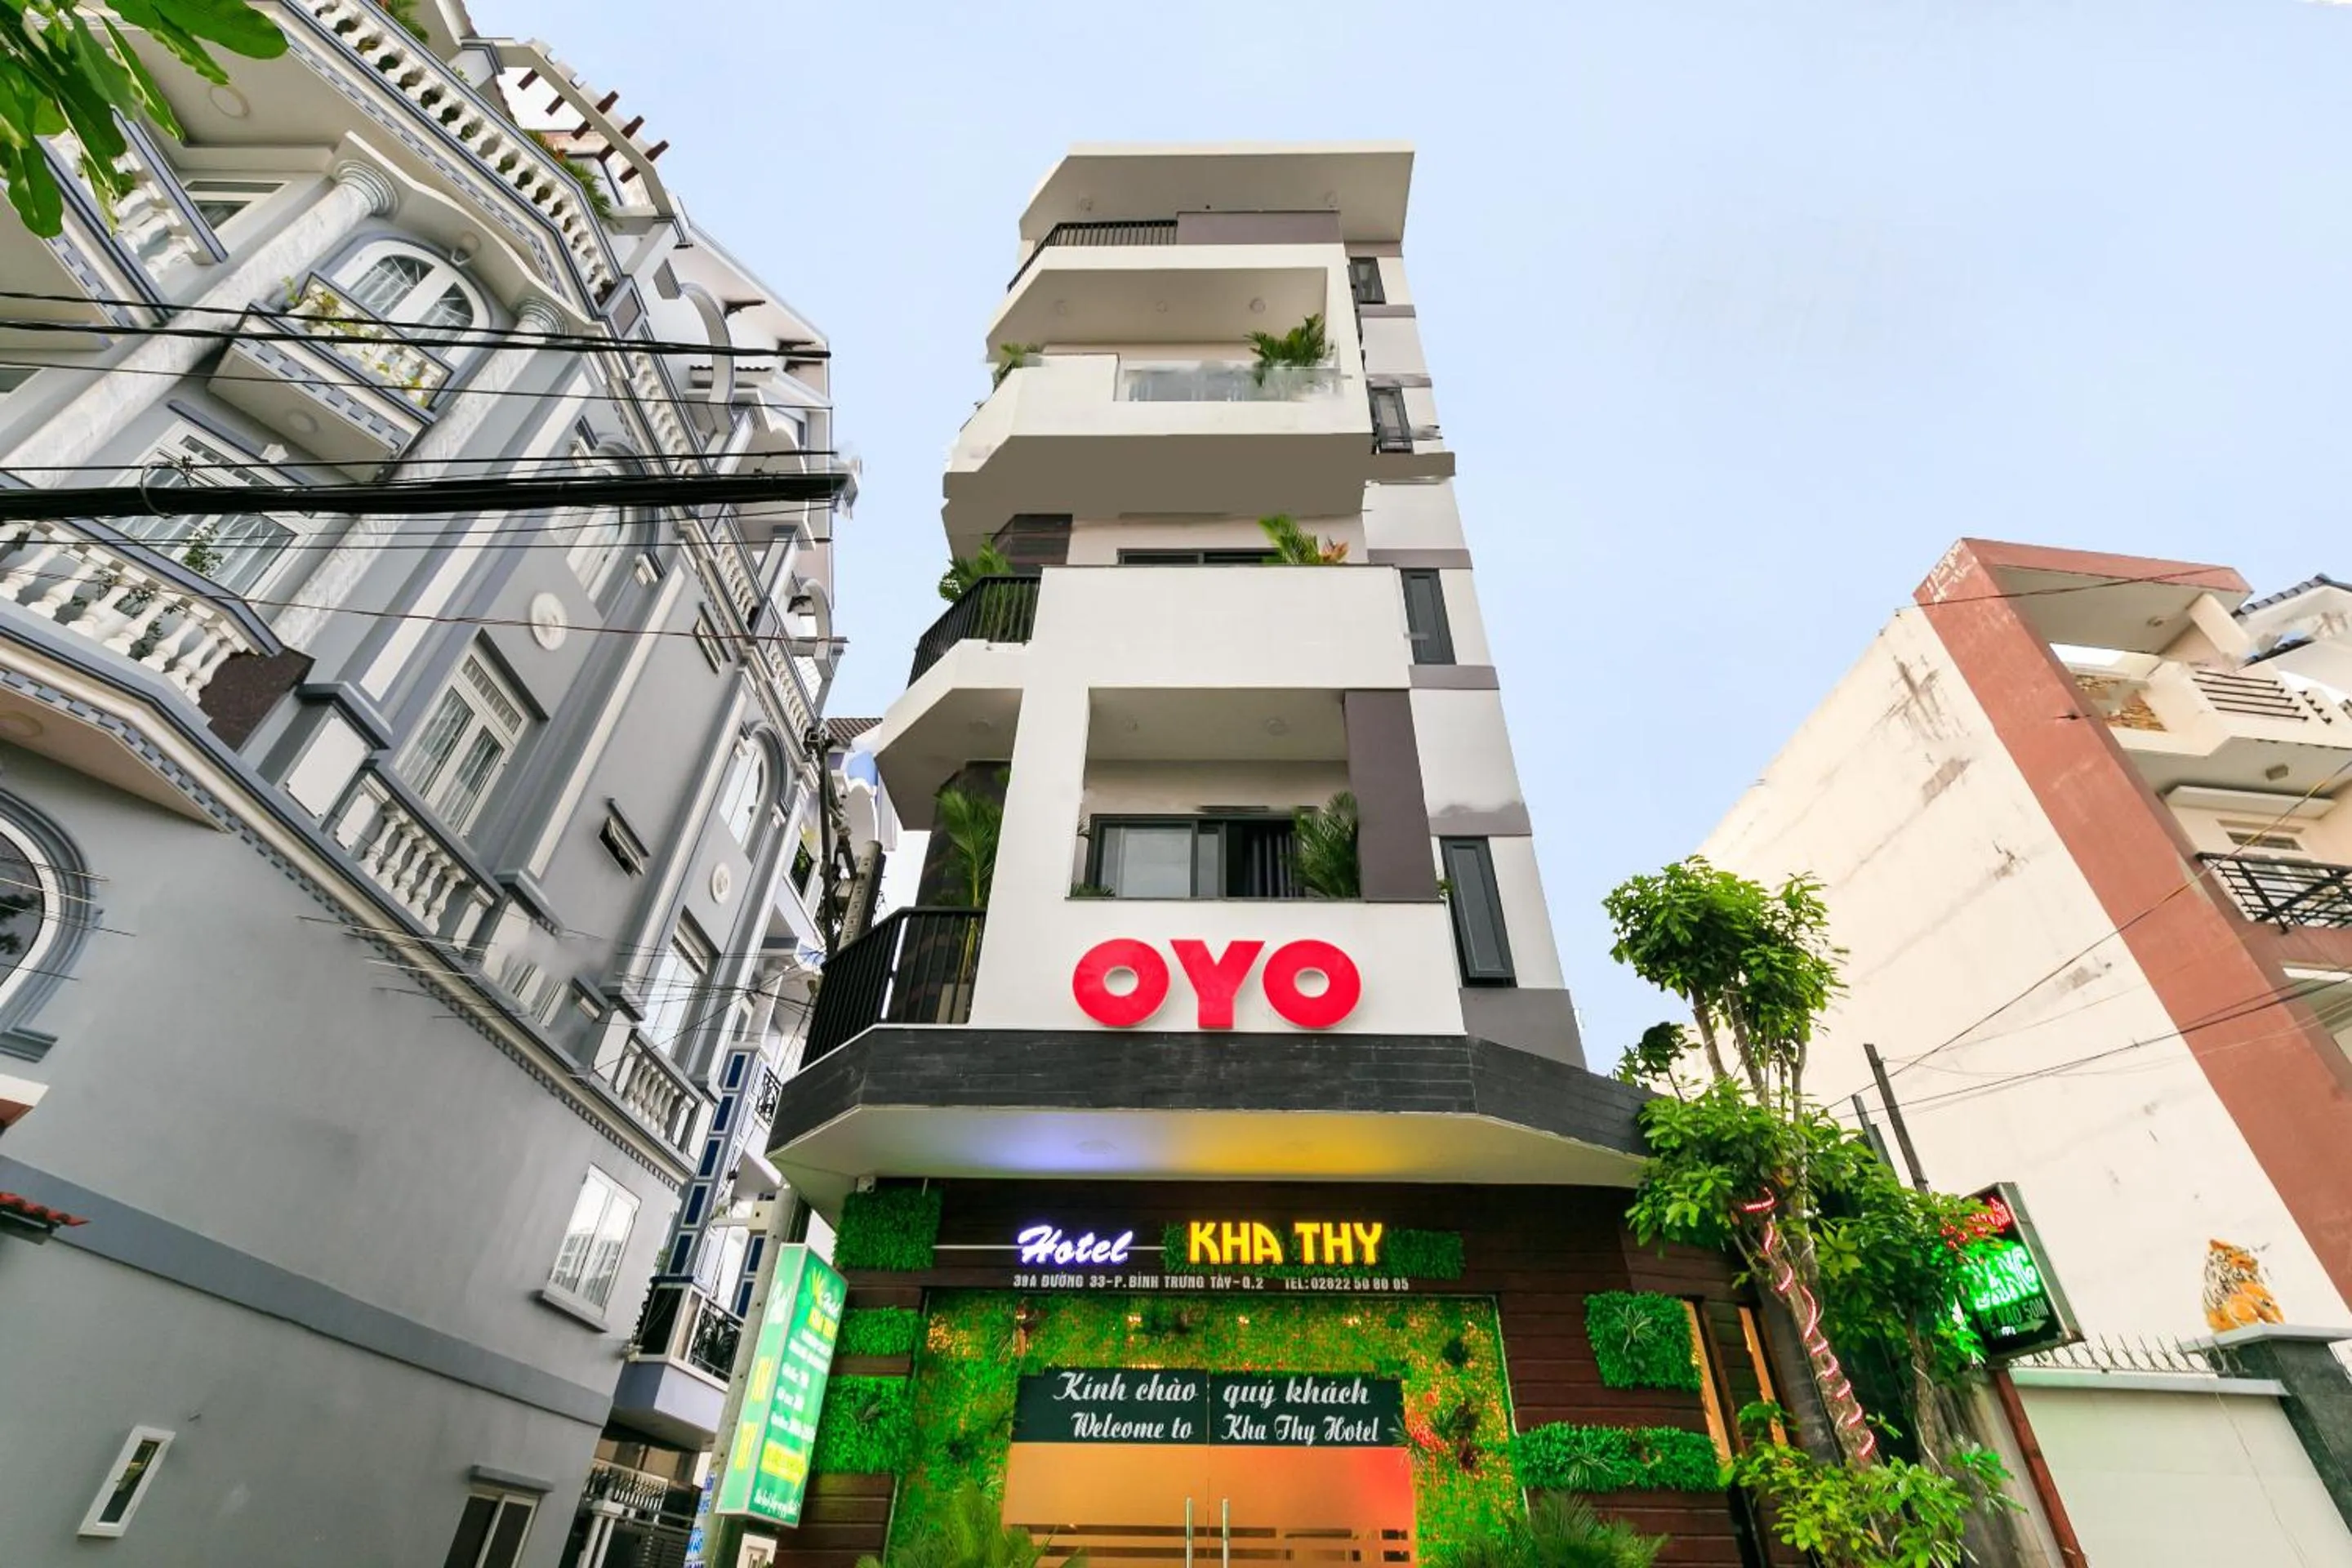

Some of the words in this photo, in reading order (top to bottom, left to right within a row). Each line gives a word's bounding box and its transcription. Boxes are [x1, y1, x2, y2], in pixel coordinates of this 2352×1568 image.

[1071, 938, 1362, 1030] OYO
[1018, 1225, 1134, 1264] Hotel
[1189, 1222, 1283, 1264] KHA
[1294, 1223, 1383, 1265] THY
[1053, 1371, 1128, 1401] Kính
[1135, 1374, 1198, 1401] chào
[1223, 1379, 1276, 1409] quý
[1285, 1376, 1370, 1405] khách
[1071, 1411, 1165, 1439] Welcome
[1171, 1417, 1193, 1439] to
[1221, 1414, 1267, 1441] Kha
[1275, 1414, 1316, 1446] Thy
[1323, 1414, 1379, 1441] Hotel
